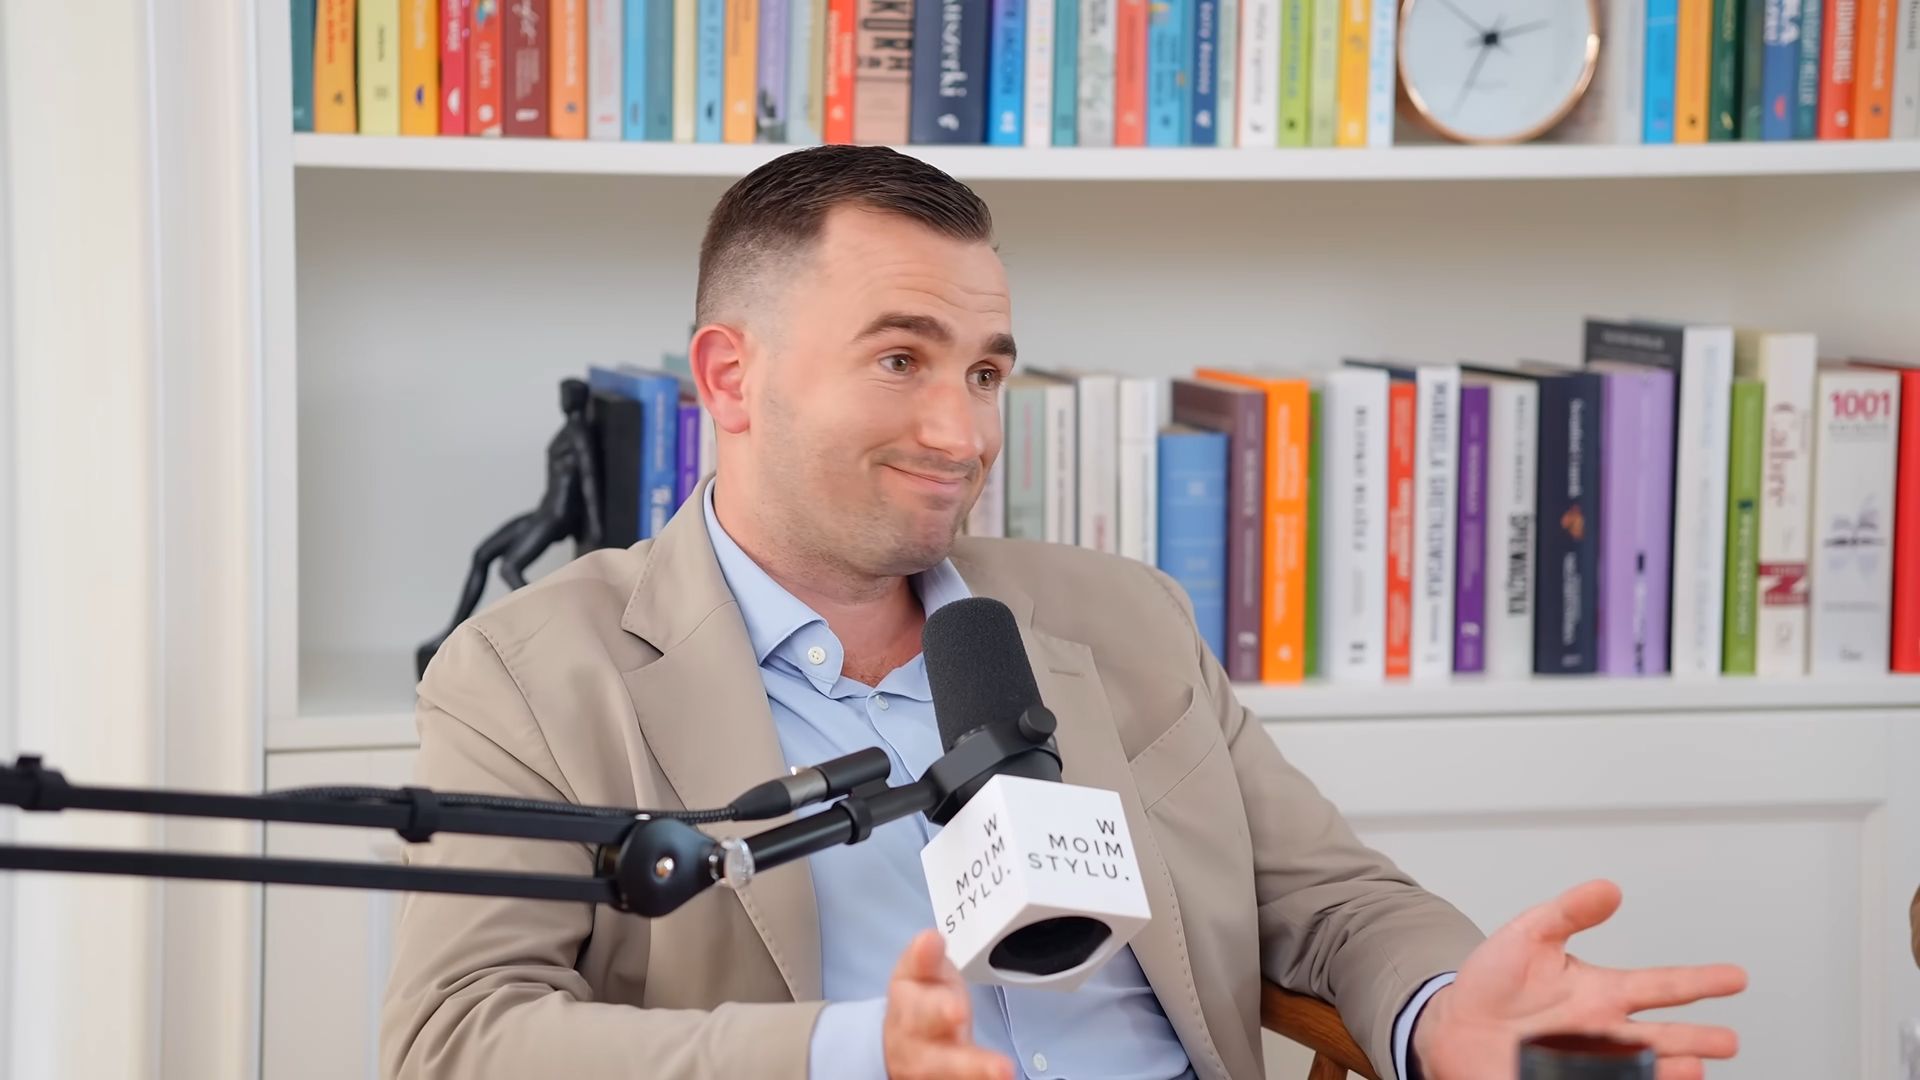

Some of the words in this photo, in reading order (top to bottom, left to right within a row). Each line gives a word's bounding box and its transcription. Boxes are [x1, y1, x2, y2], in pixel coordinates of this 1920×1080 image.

[1831, 391, 1891, 418] 1001
[984, 813, 998, 837] W
[1097, 818, 1115, 836] W
[1048, 834, 1124, 858] MOIM
[956, 836, 1006, 895] MOIM
[1028, 853, 1130, 881] STYLU.
[945, 867, 1011, 933] STYLU.
